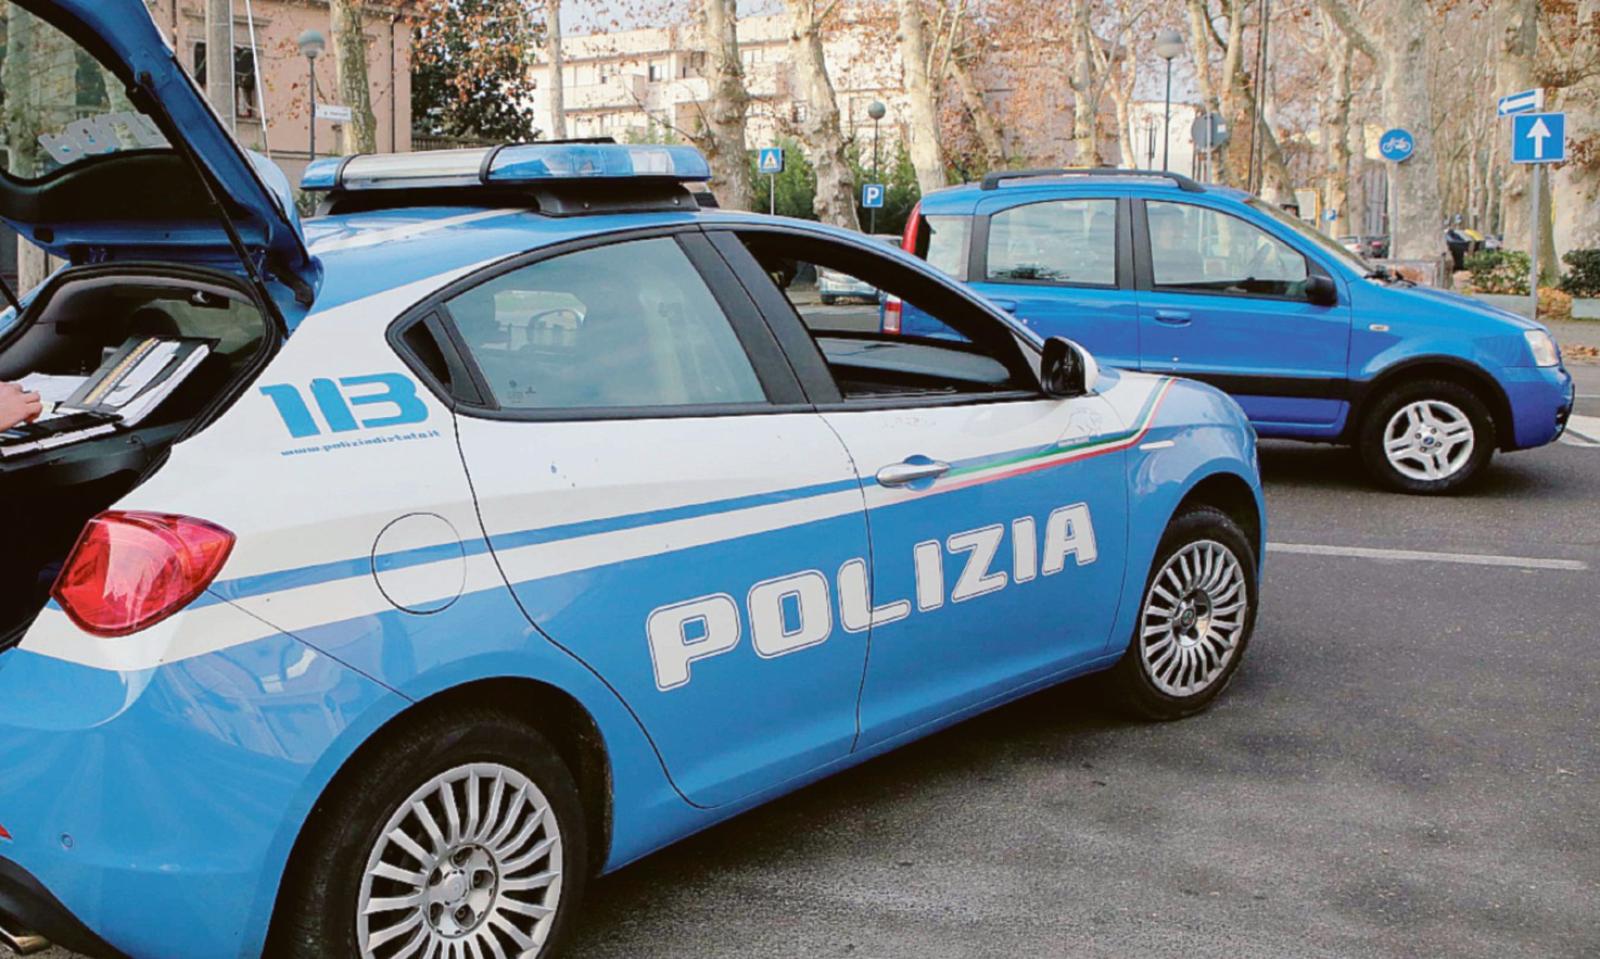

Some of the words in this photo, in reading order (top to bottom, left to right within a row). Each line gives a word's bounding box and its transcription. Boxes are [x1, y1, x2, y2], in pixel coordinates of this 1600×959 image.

[867, 187, 880, 204] P
[259, 372, 429, 439] 113
[281, 429, 441, 456] www.poliziadistato.it
[646, 502, 1098, 692] POLIZIA
